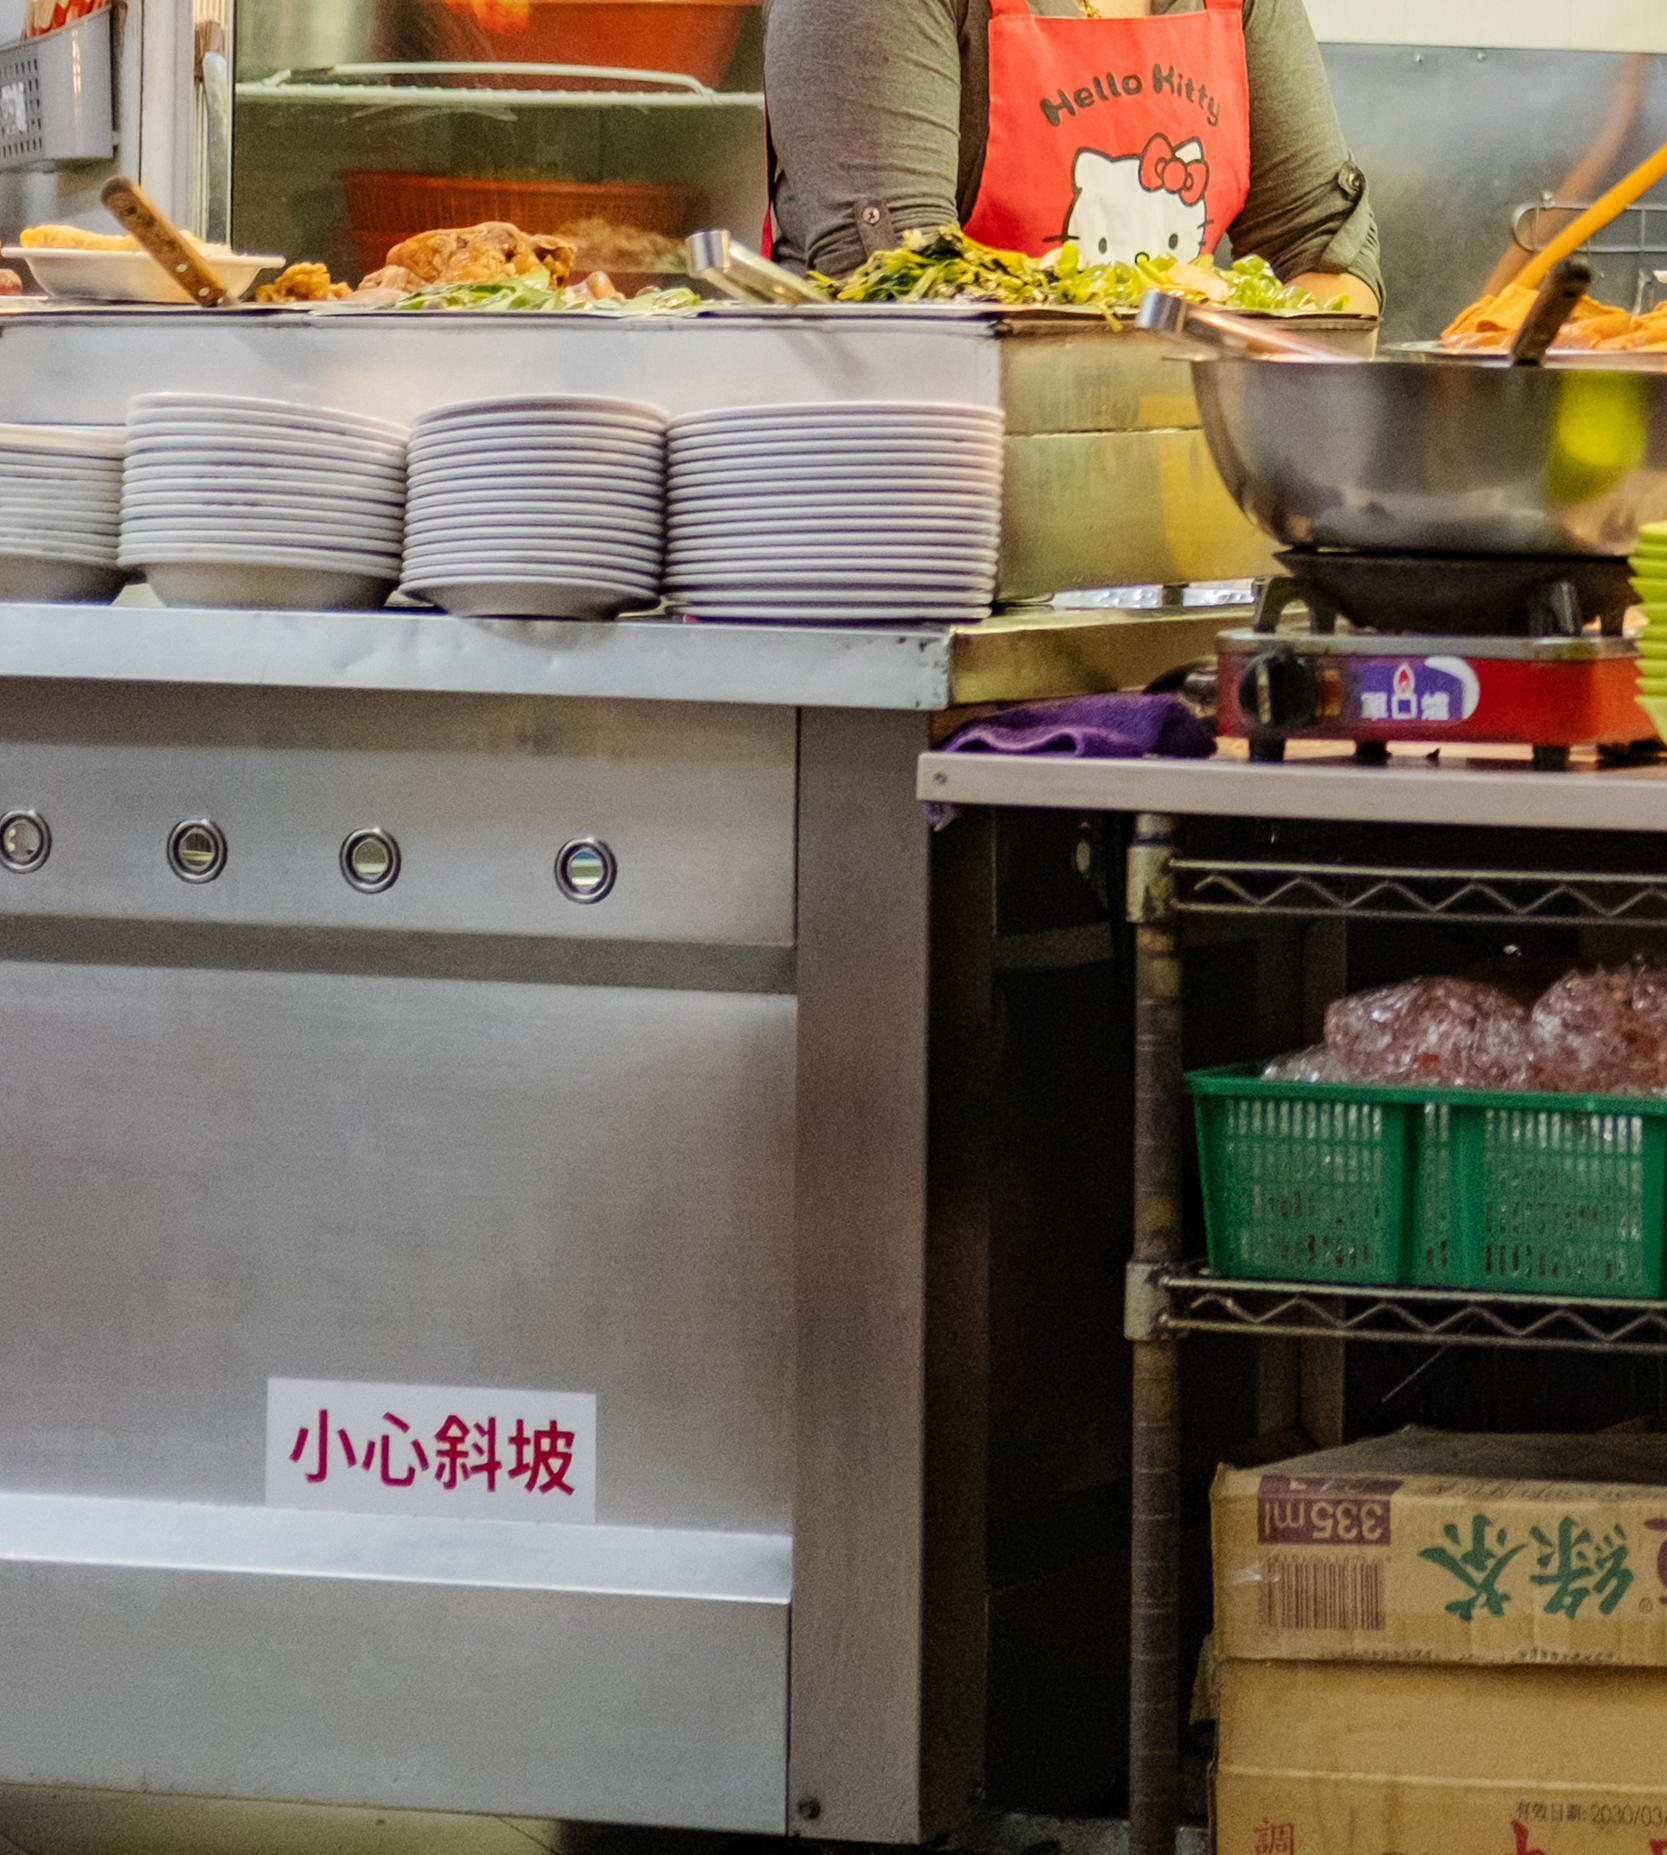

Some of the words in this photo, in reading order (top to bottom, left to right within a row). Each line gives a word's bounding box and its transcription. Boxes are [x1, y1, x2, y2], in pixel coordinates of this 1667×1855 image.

[1040, 72, 1143, 127] Hello
[1152, 63, 1221, 127] Kitty
[288, 1409, 576, 1496] 小心斜坡
